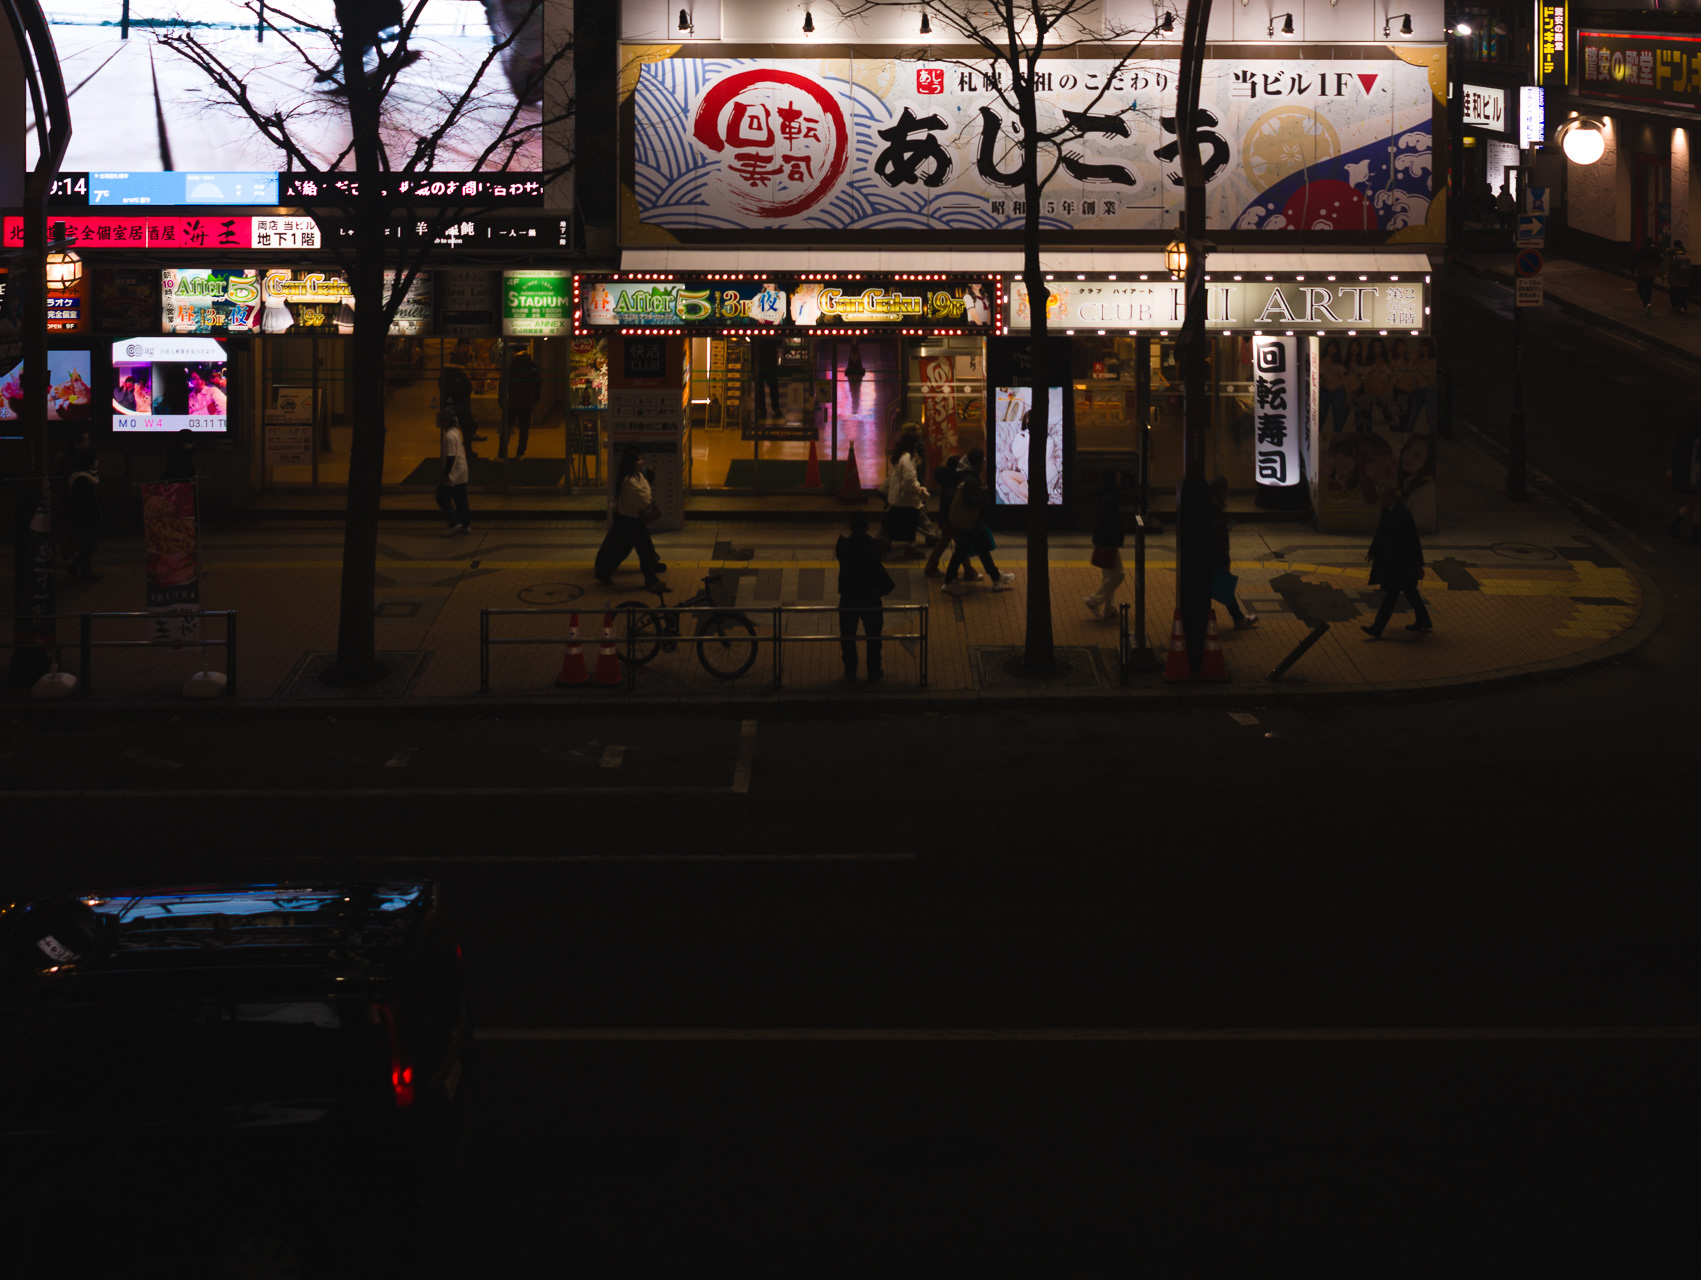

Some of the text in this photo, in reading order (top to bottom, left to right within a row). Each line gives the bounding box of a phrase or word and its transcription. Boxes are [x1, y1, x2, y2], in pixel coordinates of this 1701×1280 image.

[1233, 70, 1355, 98] 当ビル1F
[726, 101, 820, 150] 回転
[728, 152, 814, 187] 寿司
[991, 199, 1117, 215] 昭和5年創業
[183, 220, 240, 246] 海王
[283, 221, 316, 231] 当ビル
[257, 232, 315, 247] 地下1階
[175, 276, 226, 297] After
[227, 276, 259, 302] 5
[507, 278, 520, 286] 4F
[47, 299, 73, 307] ラオケ
[508, 291, 569, 307] STADIUM
[590, 290, 610, 312] 昼
[613, 289, 675, 313] After
[676, 289, 711, 320] 5
[722, 290, 755, 318] 3F
[760, 290, 779, 312] 夜
[817, 288, 922, 315] GanGaku
[933, 290, 966, 319] 9F
[1079, 303, 1152, 321] CLUB
[1254, 286, 1380, 323] ART
[47, 311, 78, 319] 完全個室
[178, 305, 195, 322] 昼
[205, 308, 226, 326] 3F
[229, 305, 248, 325] 夜
[630, 343, 660, 359] 快活
[630, 360, 660, 371] CLUB
[1256, 341, 1288, 483] 回転寿司
[119, 419, 127, 427] M
[144, 419, 153, 427] W
[156, 419, 162, 427] 4
[189, 419, 214, 427] 03.11
